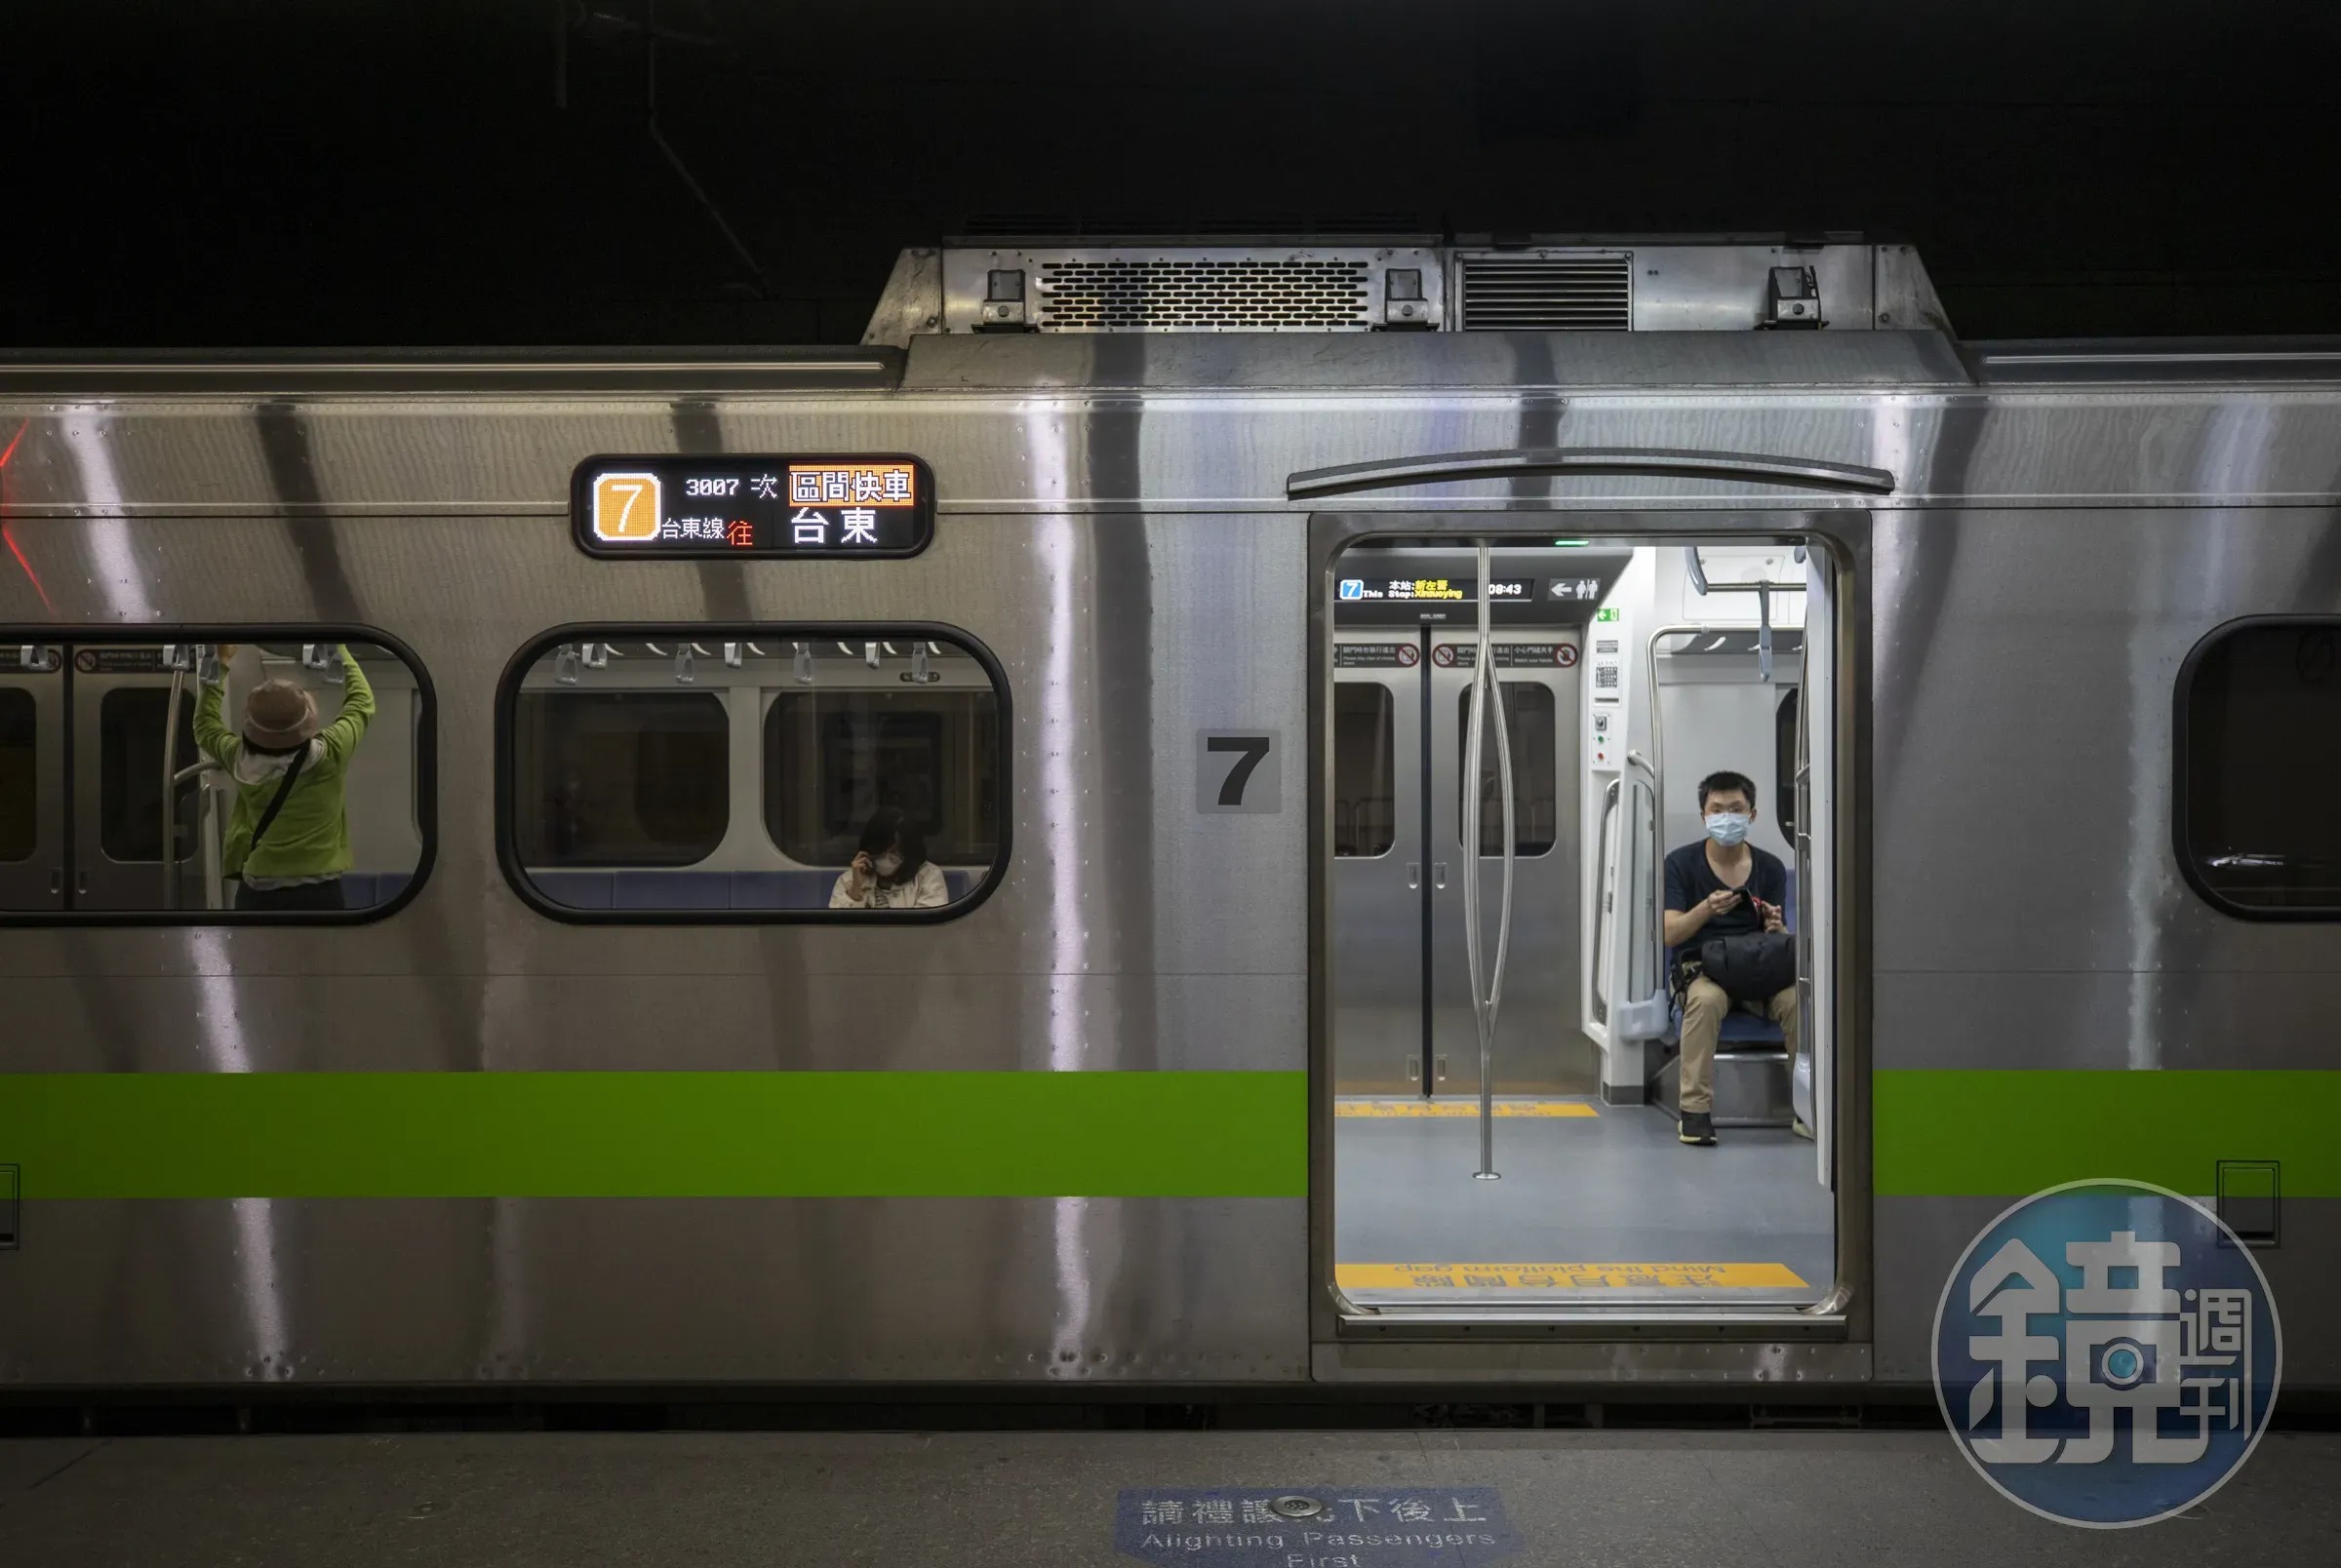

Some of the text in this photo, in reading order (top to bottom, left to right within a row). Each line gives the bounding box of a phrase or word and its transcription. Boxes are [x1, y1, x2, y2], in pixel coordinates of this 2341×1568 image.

[686, 473, 778, 500] 3007 次
[789, 469, 911, 504] 區間快車
[610, 484, 644, 533] 7
[661, 517, 754, 546] 台東線 往
[790, 506, 879, 544] 台東
[1363, 590, 1383, 599] This
[1488, 583, 1523, 595] 08:43
[1208, 737, 1270, 805] 7
[1139, 1531, 1496, 1552] Alighting Passengers
[1286, 1553, 1360, 1568] First
